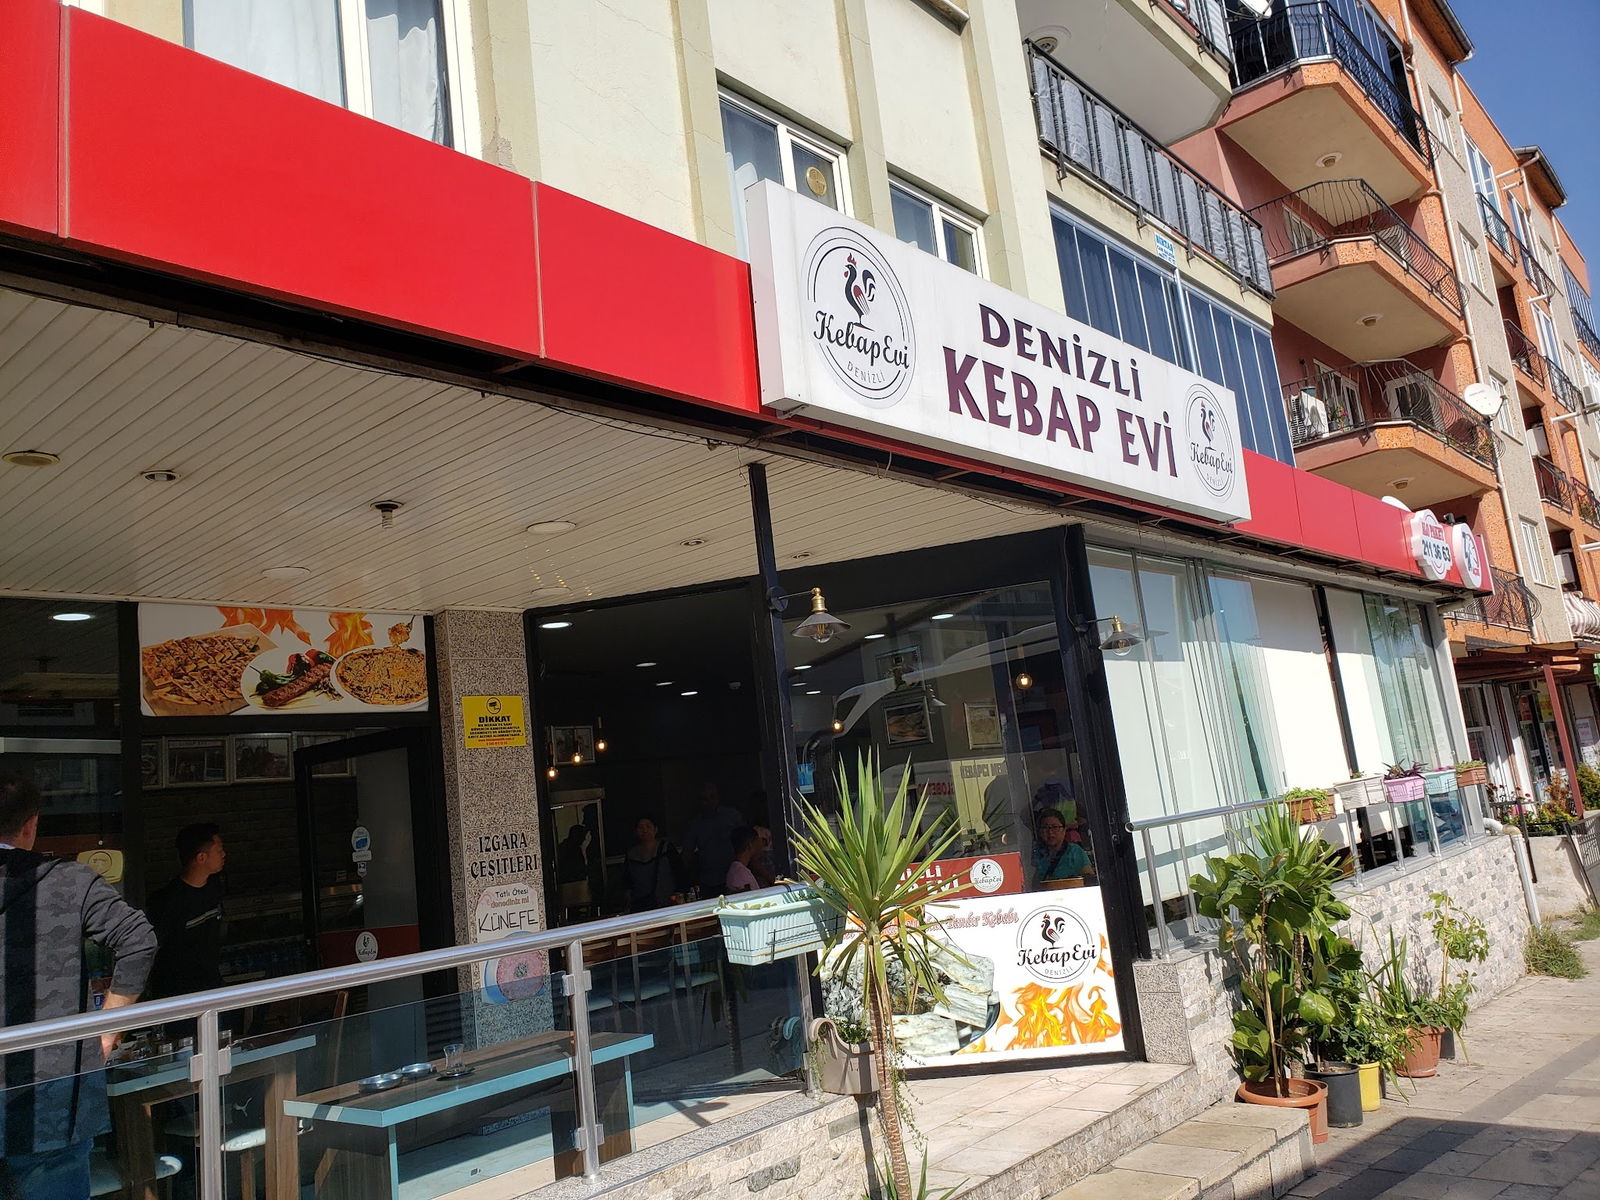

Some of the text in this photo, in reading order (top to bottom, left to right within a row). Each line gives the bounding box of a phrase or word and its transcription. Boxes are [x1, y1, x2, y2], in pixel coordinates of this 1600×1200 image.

[979, 303, 1142, 402] DENİZLİ
[847, 361, 886, 384] DENİZLİ
[942, 346, 1178, 477] KEBAP EVİ
[1422, 540, 1451, 562] 211 36 63
[478, 832, 528, 853] IZGARA
[478, 909, 539, 934] KÜNEFE
